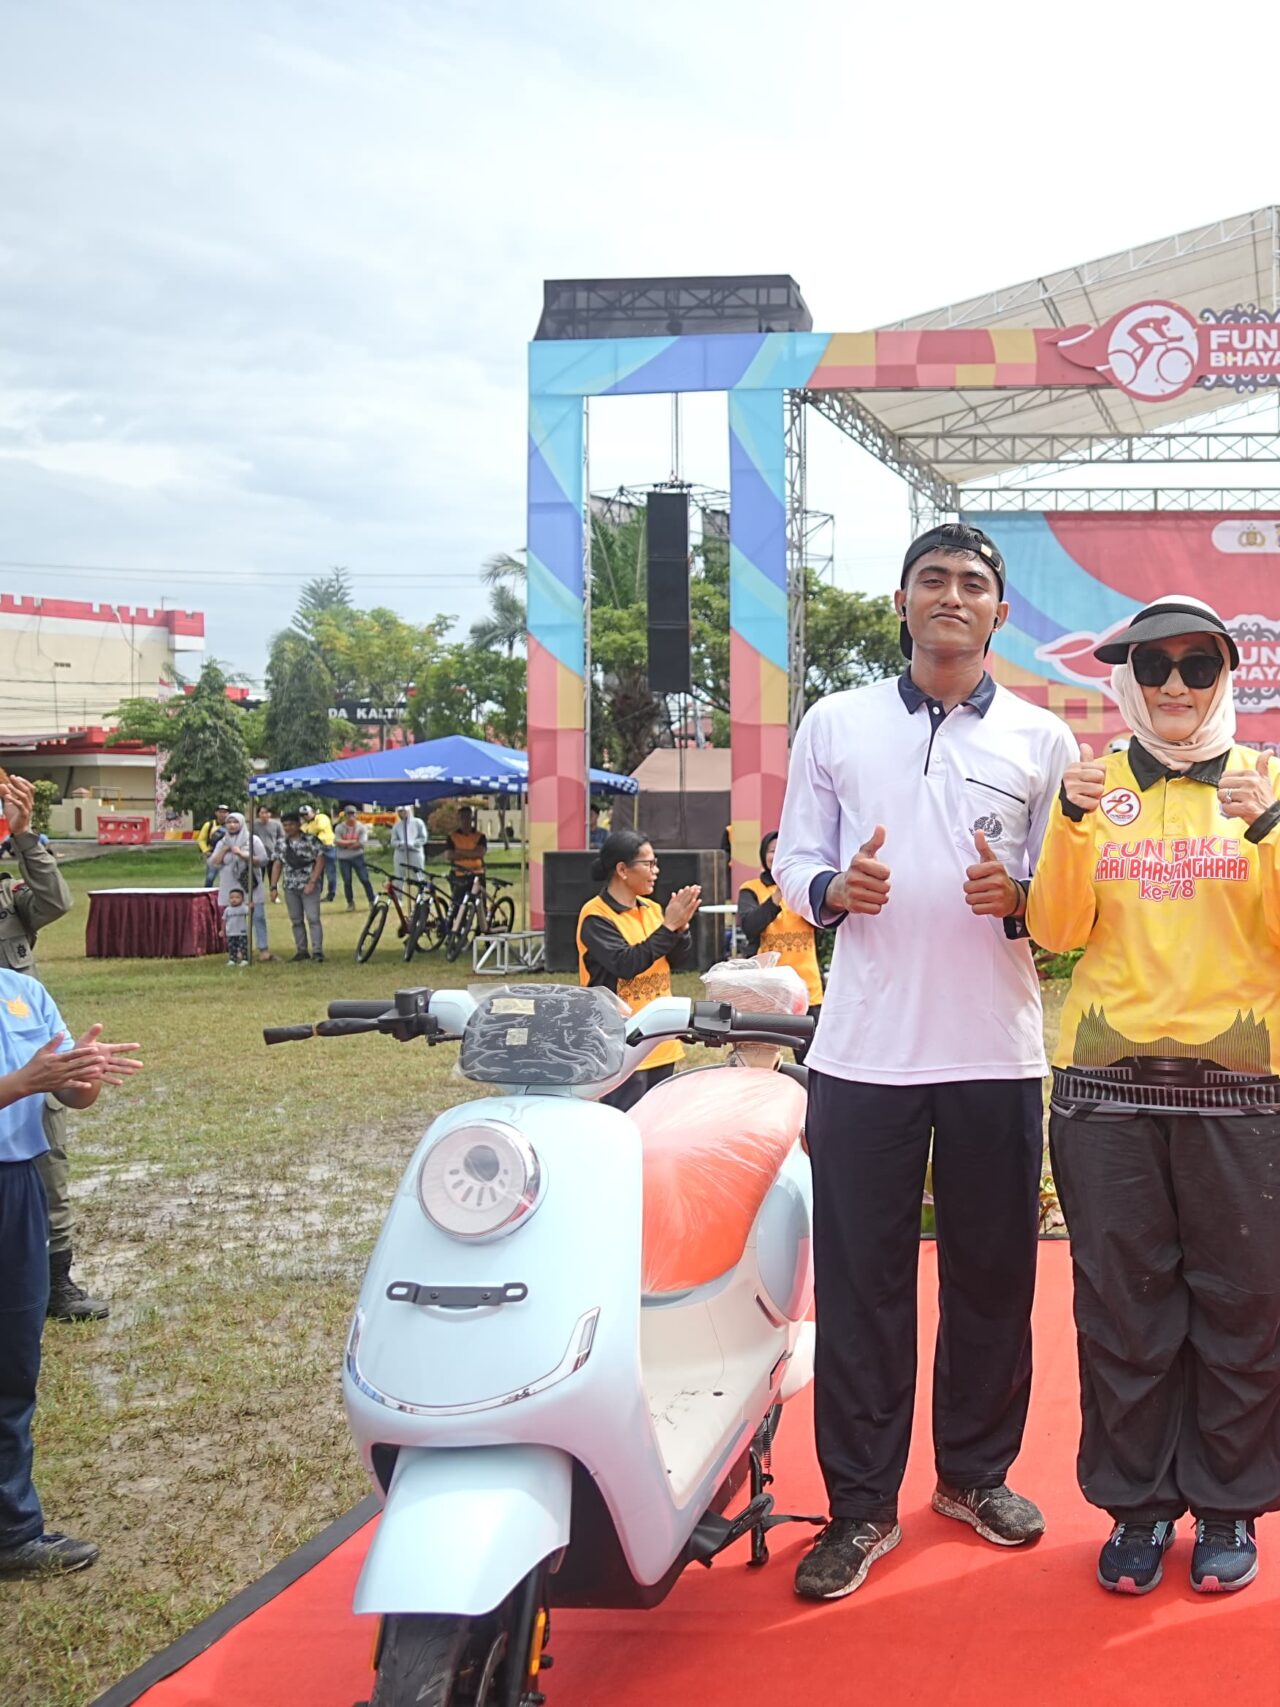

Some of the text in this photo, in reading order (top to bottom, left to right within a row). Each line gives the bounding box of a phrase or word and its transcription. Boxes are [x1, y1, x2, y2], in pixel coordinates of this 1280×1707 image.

[1209, 329, 1279, 350] FUN
[1102, 835, 1241, 861] FUN BIKE
[1128, 856, 1249, 882] BHAYANGKARA
[1139, 879, 1195, 900] ke-78
